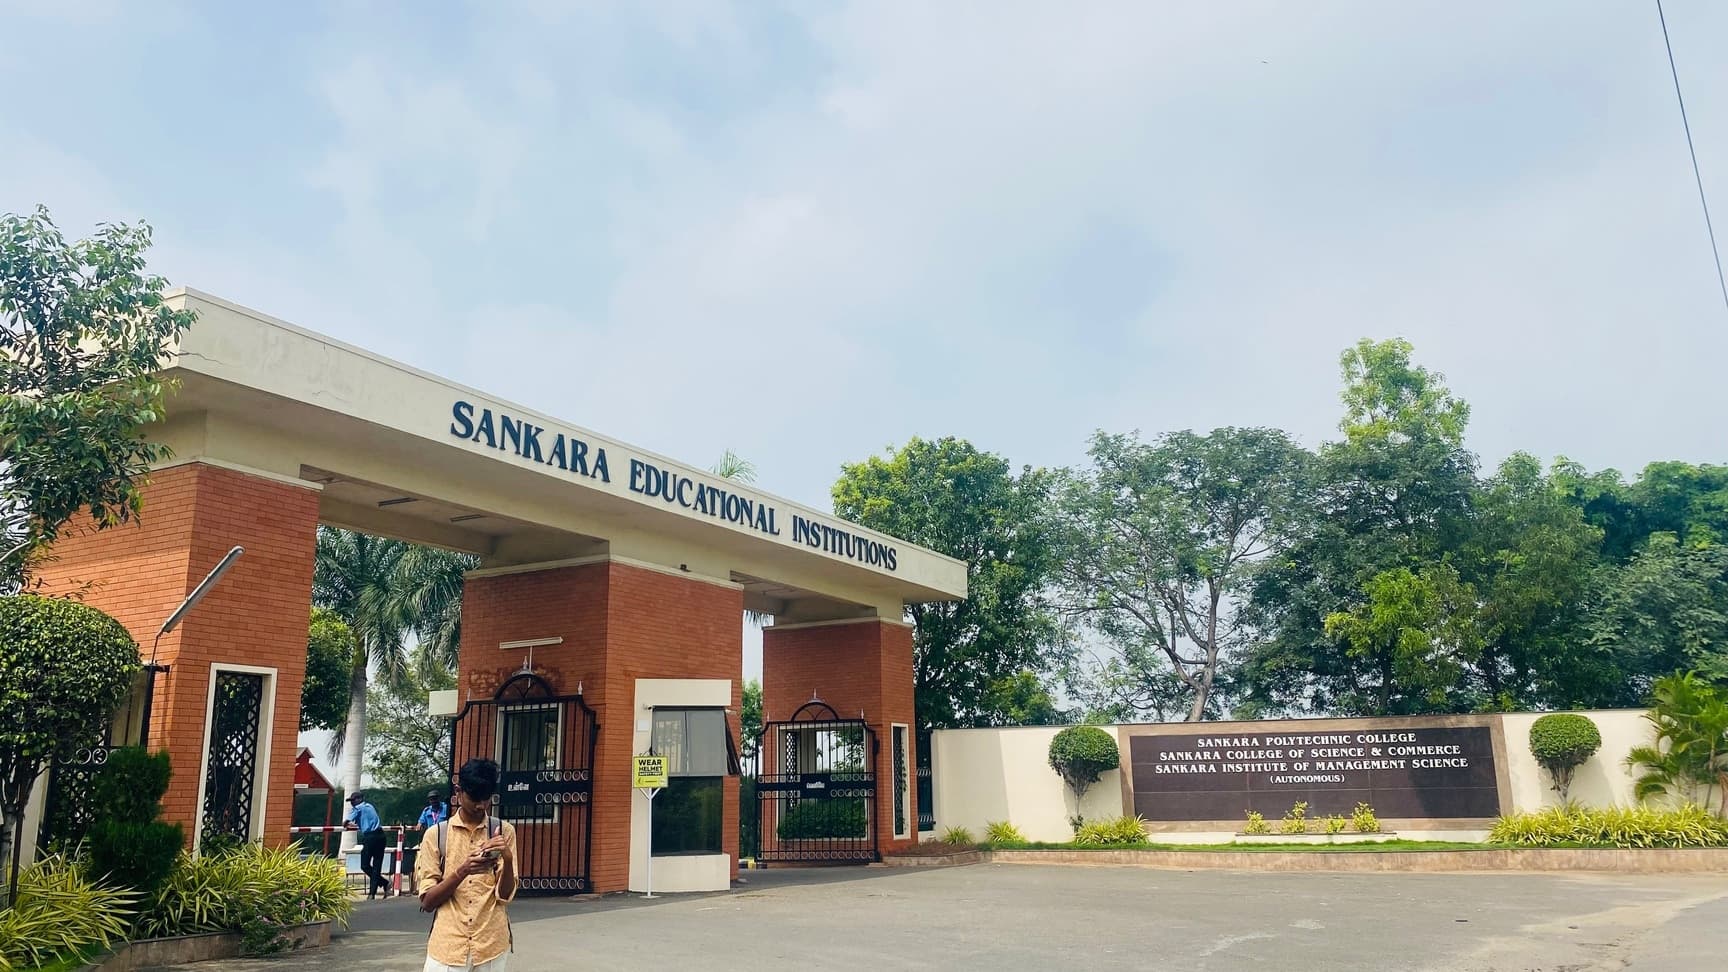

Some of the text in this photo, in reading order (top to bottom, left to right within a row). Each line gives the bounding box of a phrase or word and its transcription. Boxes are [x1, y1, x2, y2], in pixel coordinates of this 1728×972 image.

[450, 400, 898, 571] SANKARA EDUCATIONAL INSTITUTIONS
[1197, 733, 1417, 748] SANKARA POLYTECHNIC COLLEGE
[1160, 745, 1461, 761] SANKARA COLLEGE OF SCIENCE & COMMERCE
[1155, 758, 1469, 774] SANKARA INSTITUTE OF MANAGEMENT SCIENCE
[1270, 774, 1345, 784] (AUTONOMOUS)
